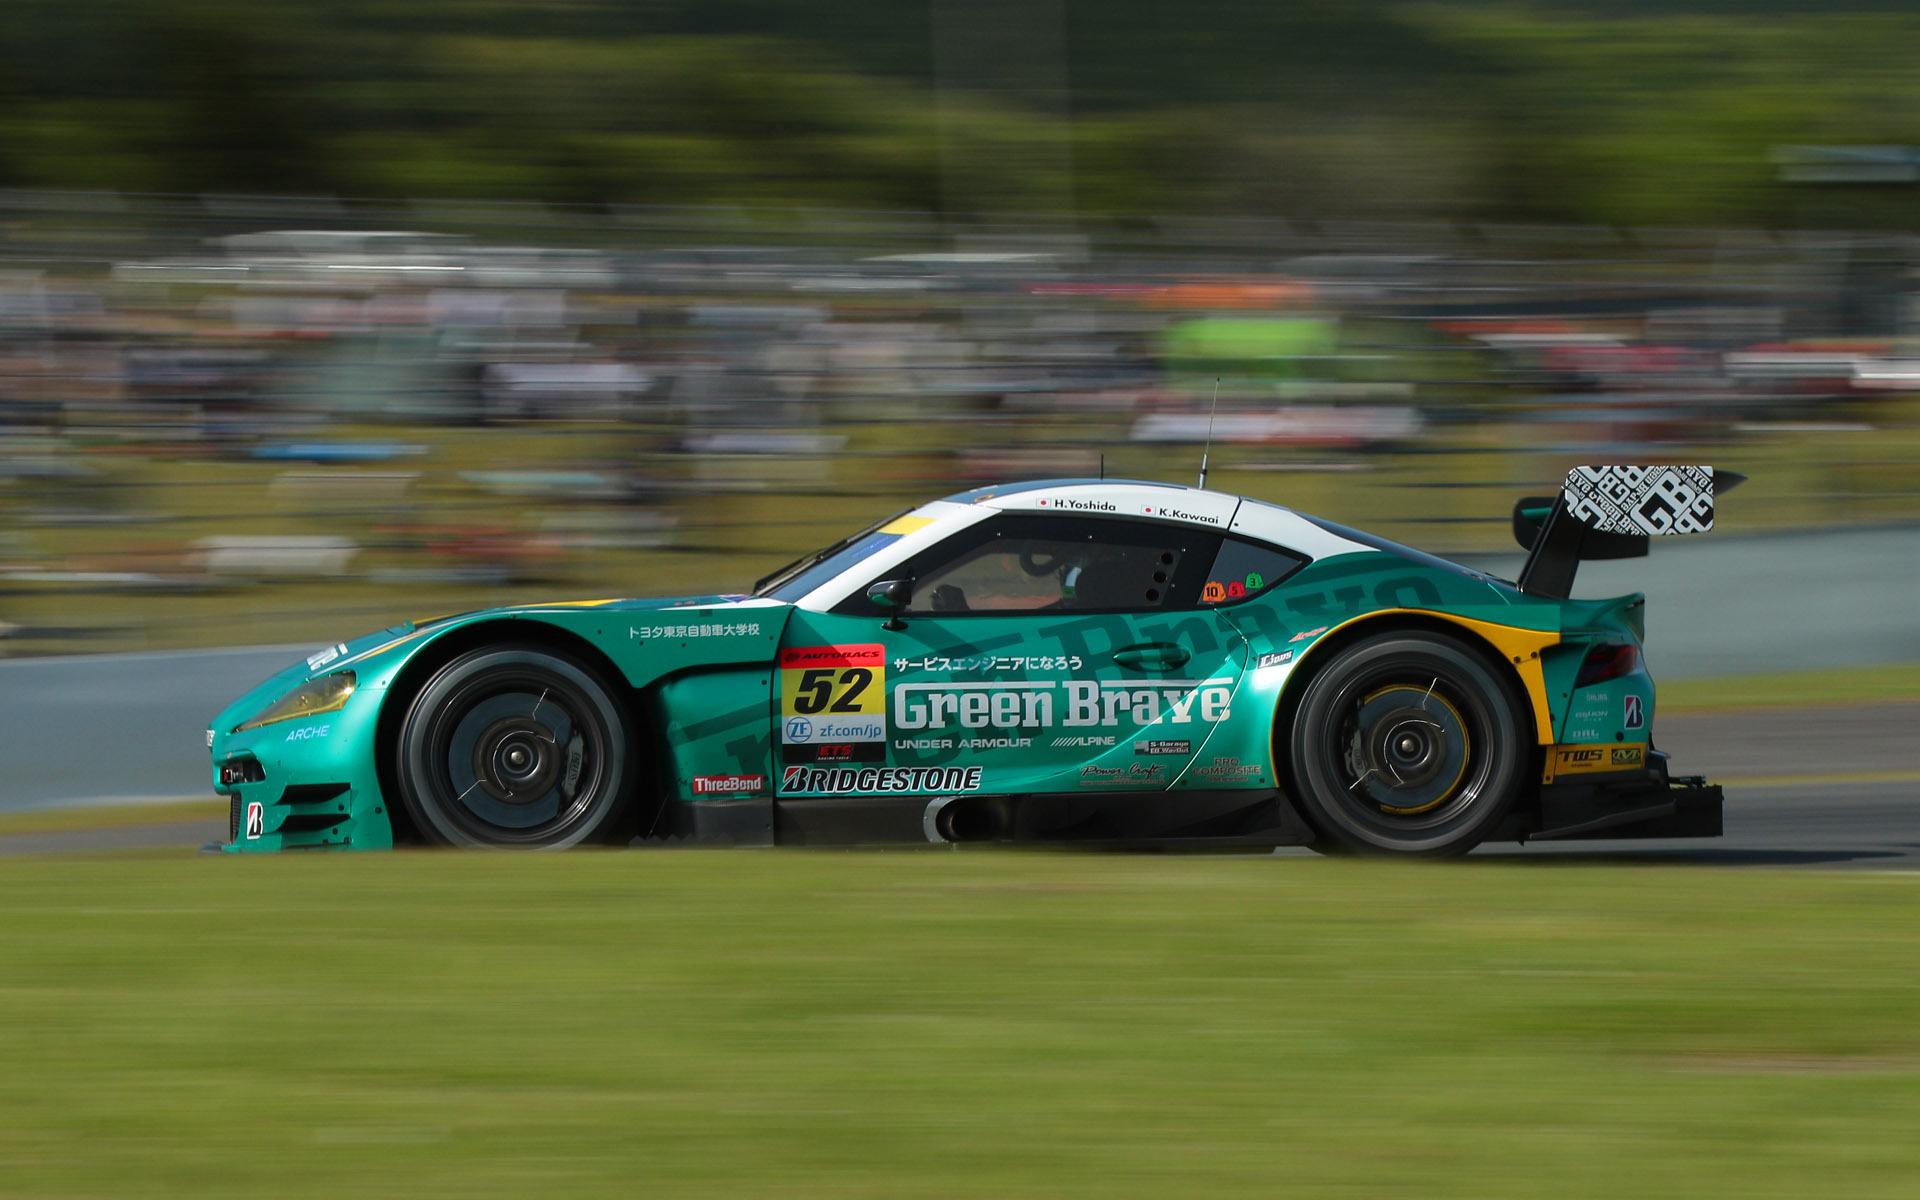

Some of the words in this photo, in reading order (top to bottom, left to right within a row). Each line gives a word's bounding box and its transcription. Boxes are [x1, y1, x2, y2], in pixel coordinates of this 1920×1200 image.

[1054, 499, 1116, 512] H.Yoshida
[1159, 508, 1219, 524] K.Kawaai
[1250, 578, 1256, 587] 3
[1205, 587, 1218, 597] 10
[1232, 586, 1238, 595] 5
[629, 623, 760, 639] トヨタ東京自動車大学校
[802, 651, 880, 660] AUTOBACS
[893, 655, 1083, 673] サービスエンジニアになろう
[794, 668, 873, 714] 52
[894, 681, 1056, 729] Green
[1062, 677, 1234, 727] Brave
[285, 725, 331, 742] ARCHE
[820, 724, 882, 738] zf.com/jp
[895, 739, 952, 749] UNDER
[958, 737, 1032, 748] ARMOUR
[819, 745, 852, 756] ETS
[1558, 750, 1603, 762] TWS
[1213, 757, 1240, 766] PRO
[1080, 765, 1123, 777] Power
[1129, 763, 1166, 780] Craft
[1192, 765, 1262, 776] COMPOSITE
[695, 776, 762, 792] ThreeBond
[781, 766, 982, 793] BRIDGESTONE
